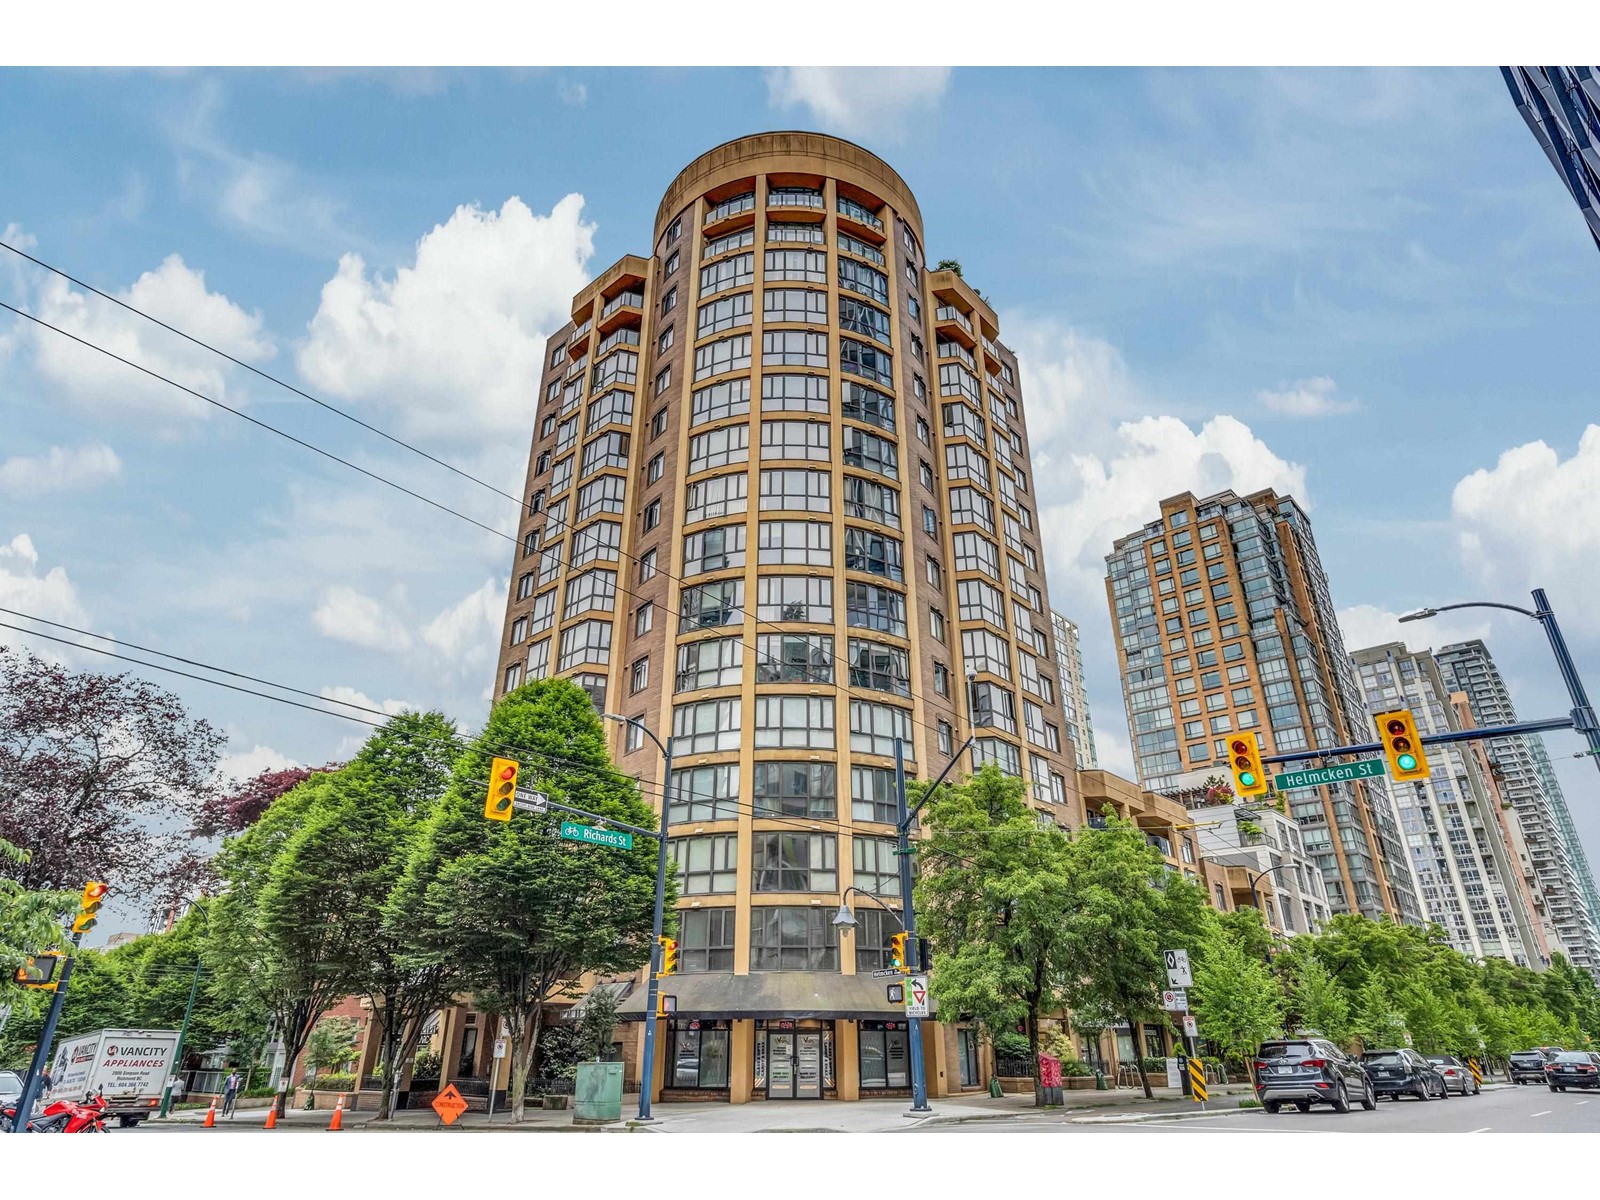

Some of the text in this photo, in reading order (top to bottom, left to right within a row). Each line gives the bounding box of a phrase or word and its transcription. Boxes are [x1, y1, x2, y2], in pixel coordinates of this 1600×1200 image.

[1285, 763, 1373, 787] Helmcken St
[516, 791, 526, 799] ONE
[583, 828, 627, 847] Richards St
[120, 1047, 168, 1056] VANCITY
[103, 1060, 165, 1068] APPLIANCES
